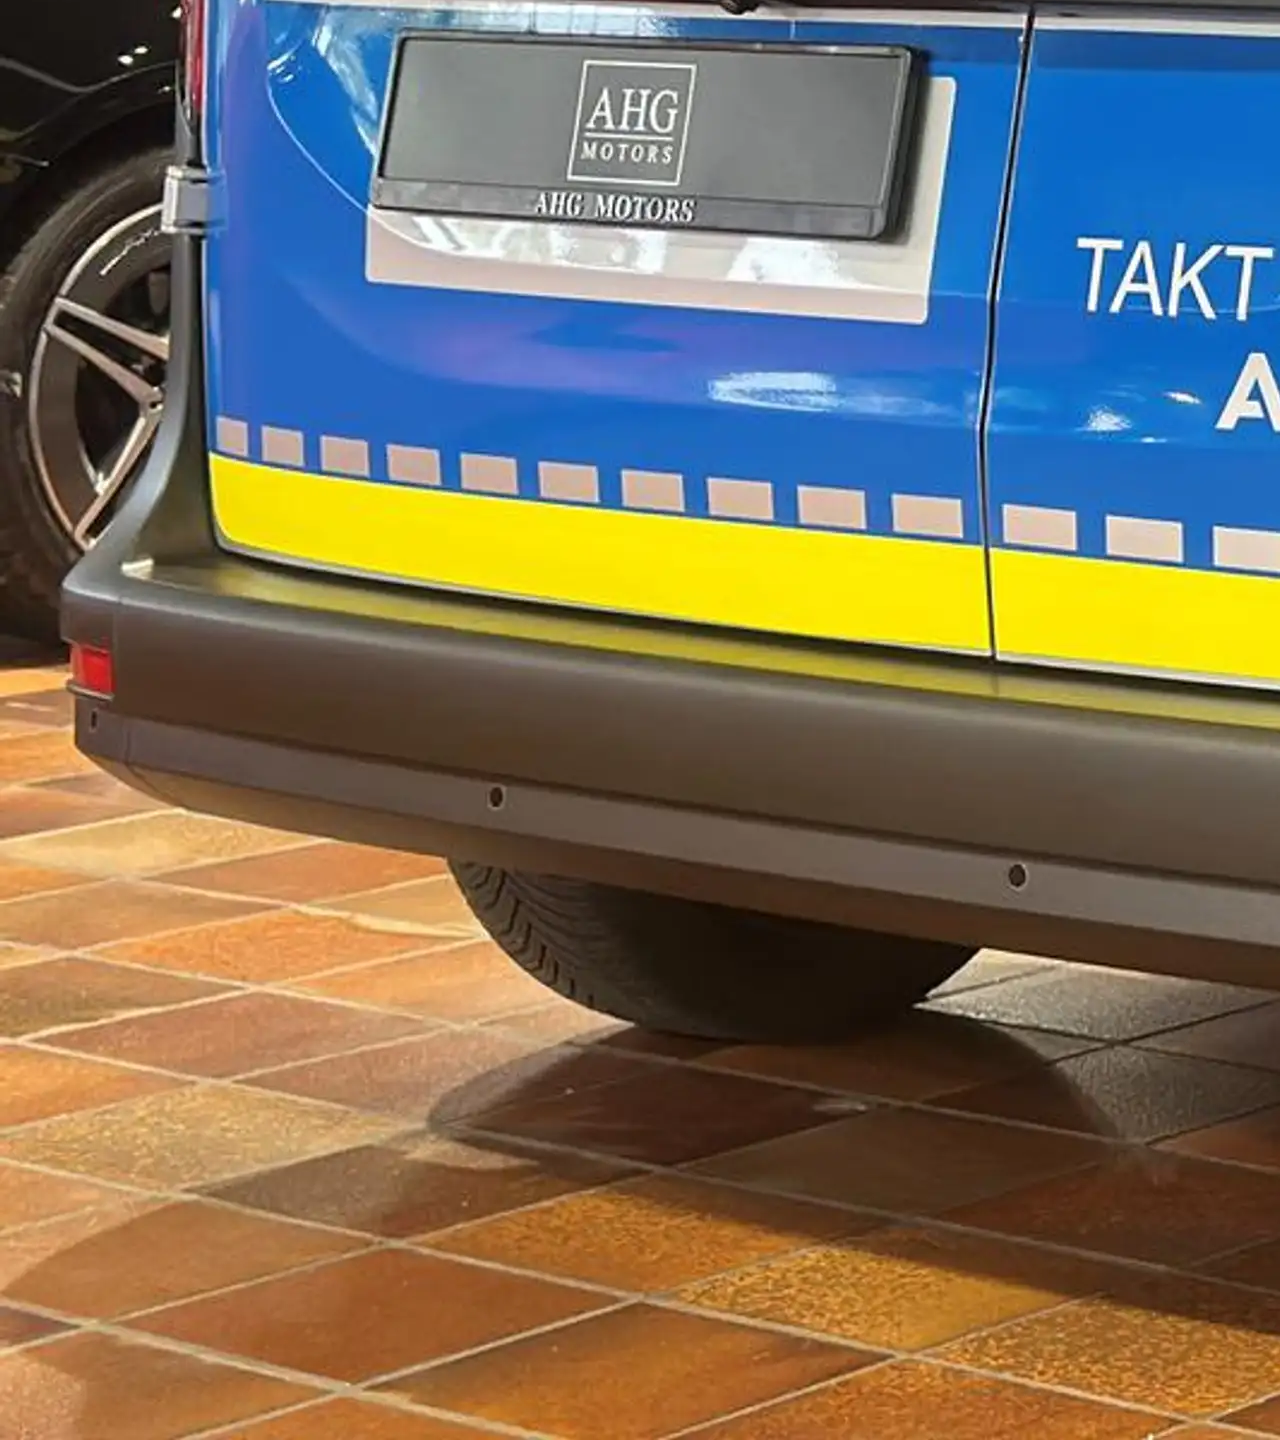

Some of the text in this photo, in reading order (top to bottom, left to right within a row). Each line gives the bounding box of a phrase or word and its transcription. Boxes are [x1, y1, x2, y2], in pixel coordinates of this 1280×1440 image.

[585, 87, 679, 134] AHG
[580, 141, 673, 164] MOTORS
[535, 191, 696, 224] AHG MOTORS
[1077, 237, 1275, 321] TAKT
